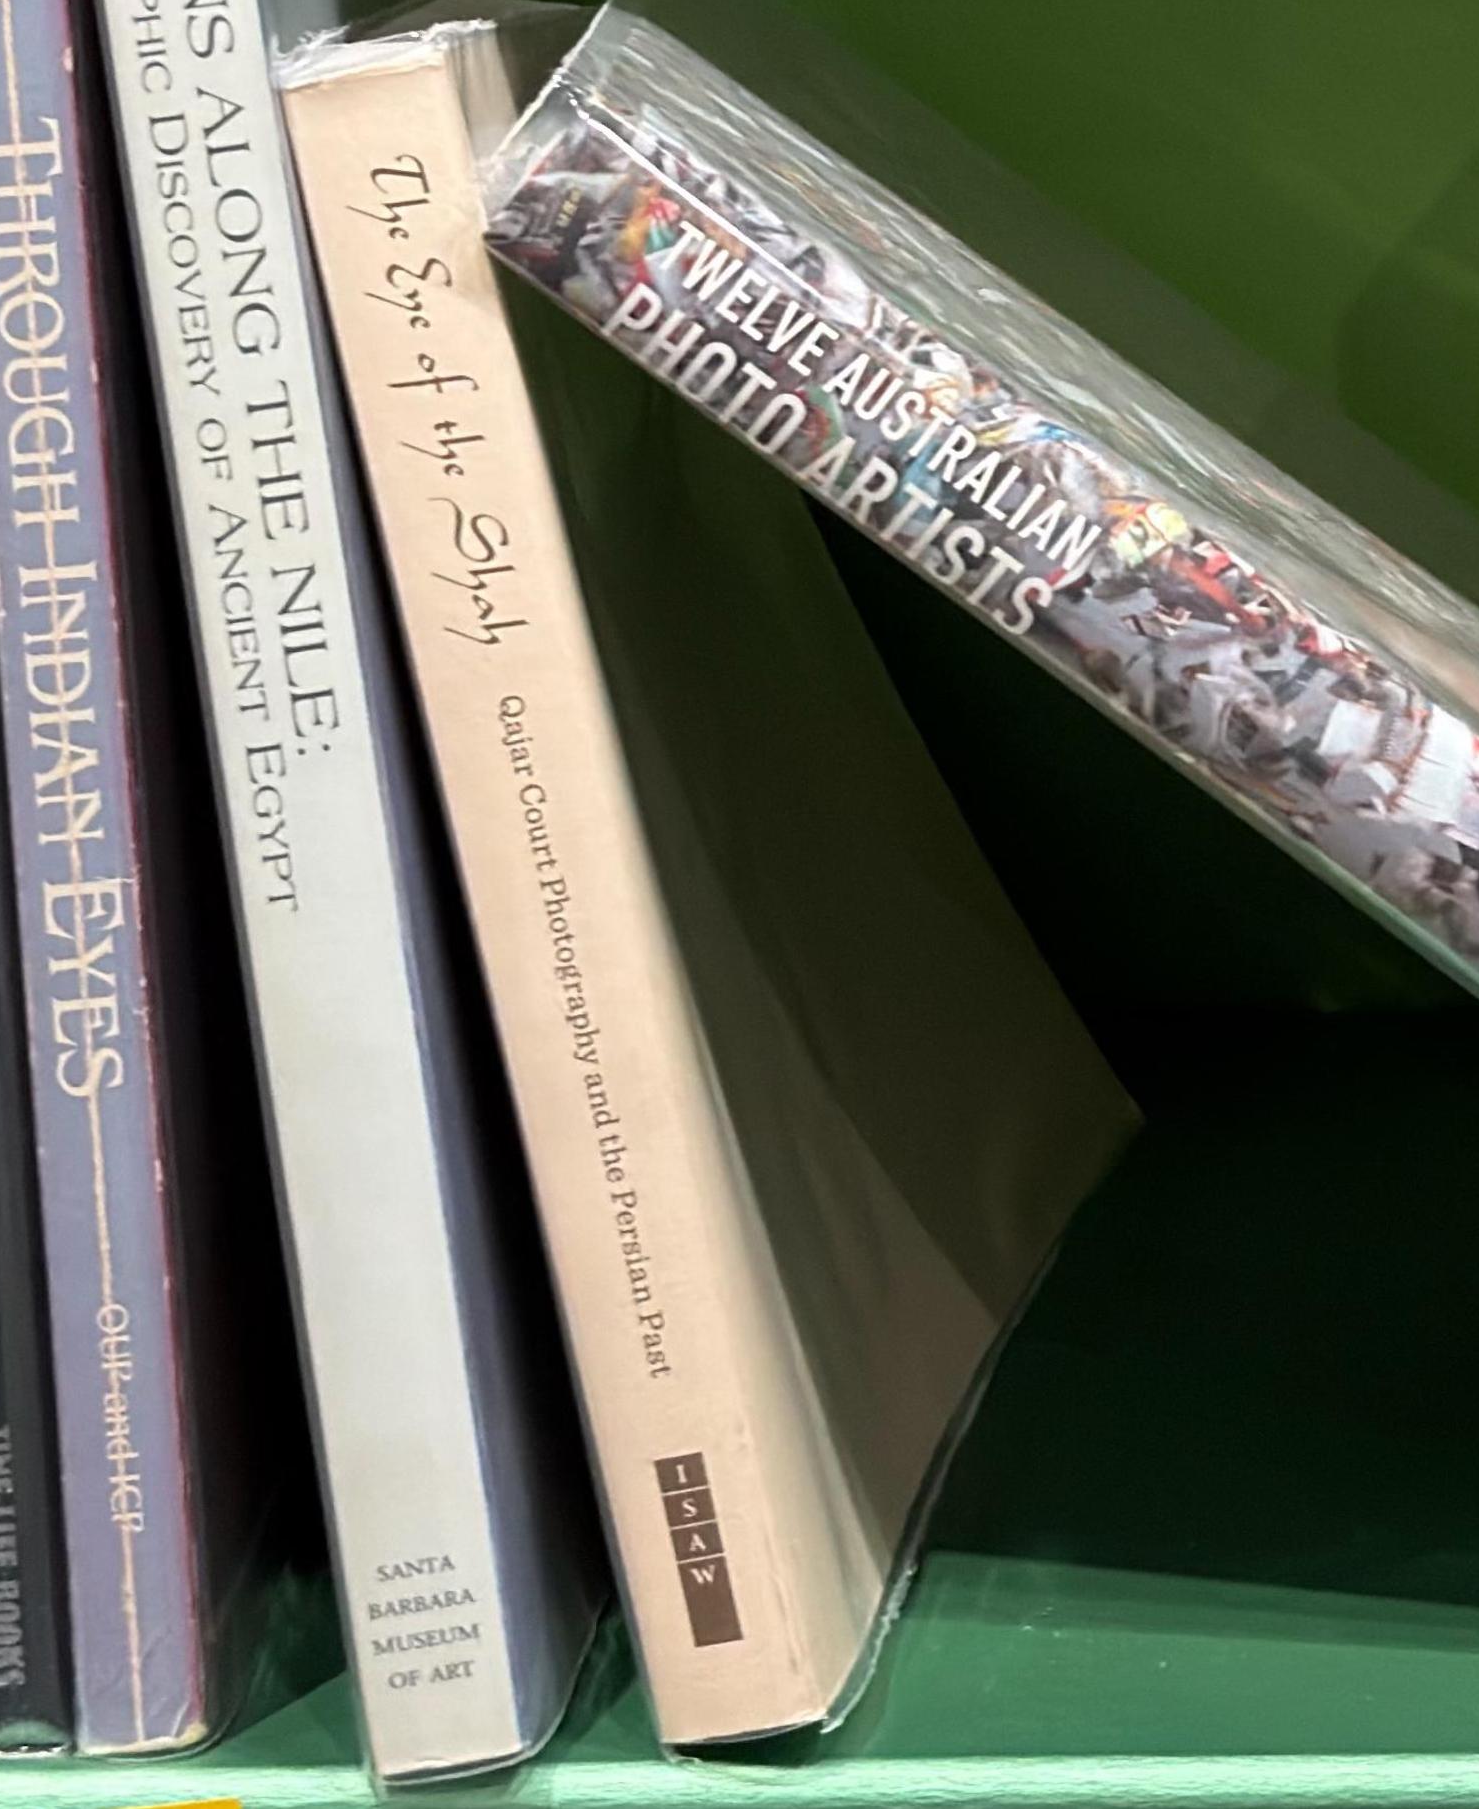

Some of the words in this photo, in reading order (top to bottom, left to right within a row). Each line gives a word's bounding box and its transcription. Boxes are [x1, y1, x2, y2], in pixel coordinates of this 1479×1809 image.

[149, 115, 219, 397] DISCOVERY
[197, 87, 279, 357] ALONG
[346, 152, 425, 247] The
[366, 258, 451, 336] Eye
[195, 417, 232, 481] OF
[388, 351, 479, 404] of
[399, 419, 467, 479] the
[654, 218, 840, 377] TWELVE
[825, 354, 1102, 570] AUSTRALIAN
[247, 382, 311, 540] THE
[605, 282, 810, 448] PHOTO
[802, 434, 1053, 638] ARTISTS
[208, 502, 270, 722] ANCIENT
[432, 494, 529, 648] Shah
[19, 560, 106, 846] INDIAN
[268, 563, 341, 757] NILE:
[244, 742, 299, 912] EGYPT
[41, 876, 126, 1098] EYES
[499, 693, 531, 777] Qajar
[520, 784, 554, 870] Court
[539, 876, 599, 1065] Photography
[584, 1069, 616, 1126] and
[600, 1130, 626, 1183] the
[613, 1191, 650, 1305] Persian
[639, 1309, 670, 1377] Past
[368, 1585, 475, 1622] BARBARA
[373, 1621, 481, 1657] MUSEUM
[376, 1551, 457, 1583] SANTA
[389, 1665, 422, 1691] OF
[430, 1658, 474, 1684] ART
